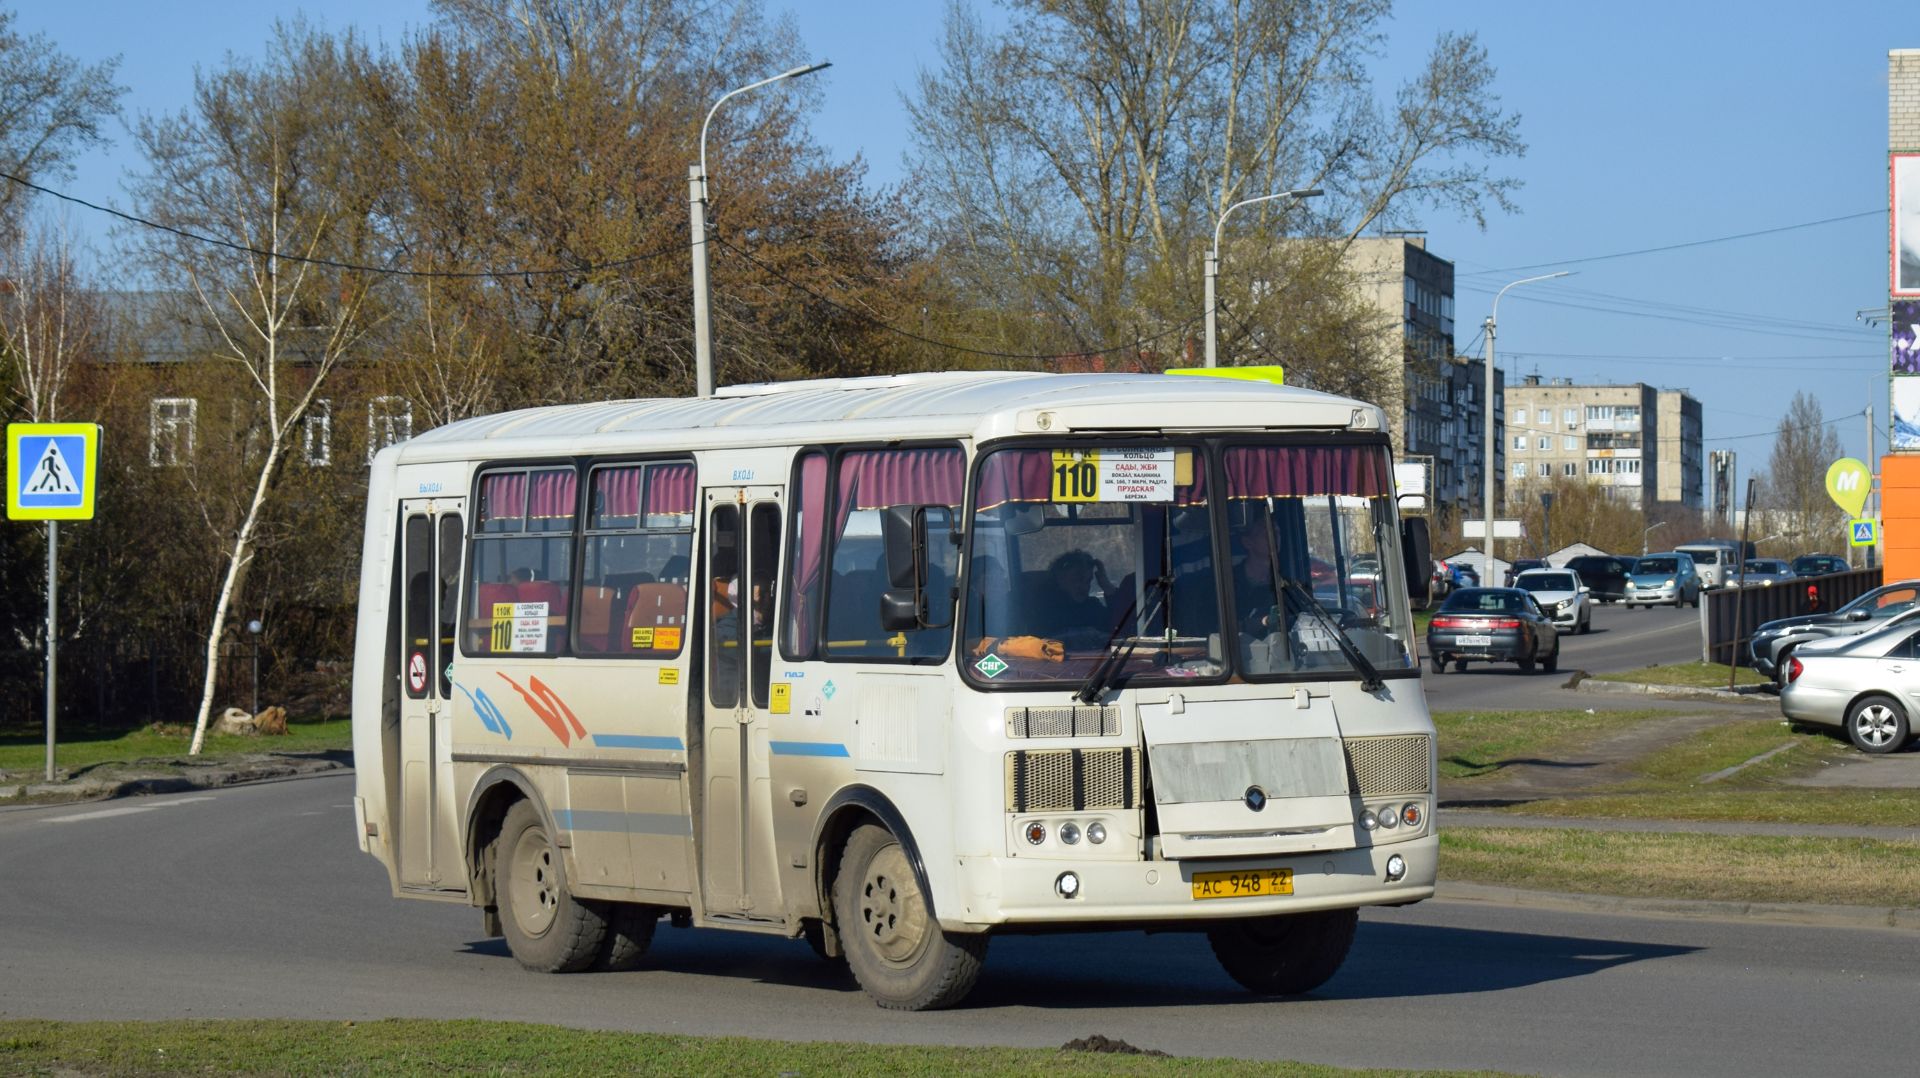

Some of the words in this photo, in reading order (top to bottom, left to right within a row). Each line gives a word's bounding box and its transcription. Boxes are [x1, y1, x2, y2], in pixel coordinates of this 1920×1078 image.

[1115, 463, 1139, 471] САДЫ,
[733, 469, 751, 480] ВХОД
[1055, 463, 1097, 498] 110
[1117, 485, 1155, 493] ПРУДСКАЯ
[496, 606, 512, 616] 110К
[494, 620, 512, 650] 110
[1202, 880, 1222, 895] АС
[1230, 874, 1260, 893] 948
[1271, 871, 1287, 886] 22
